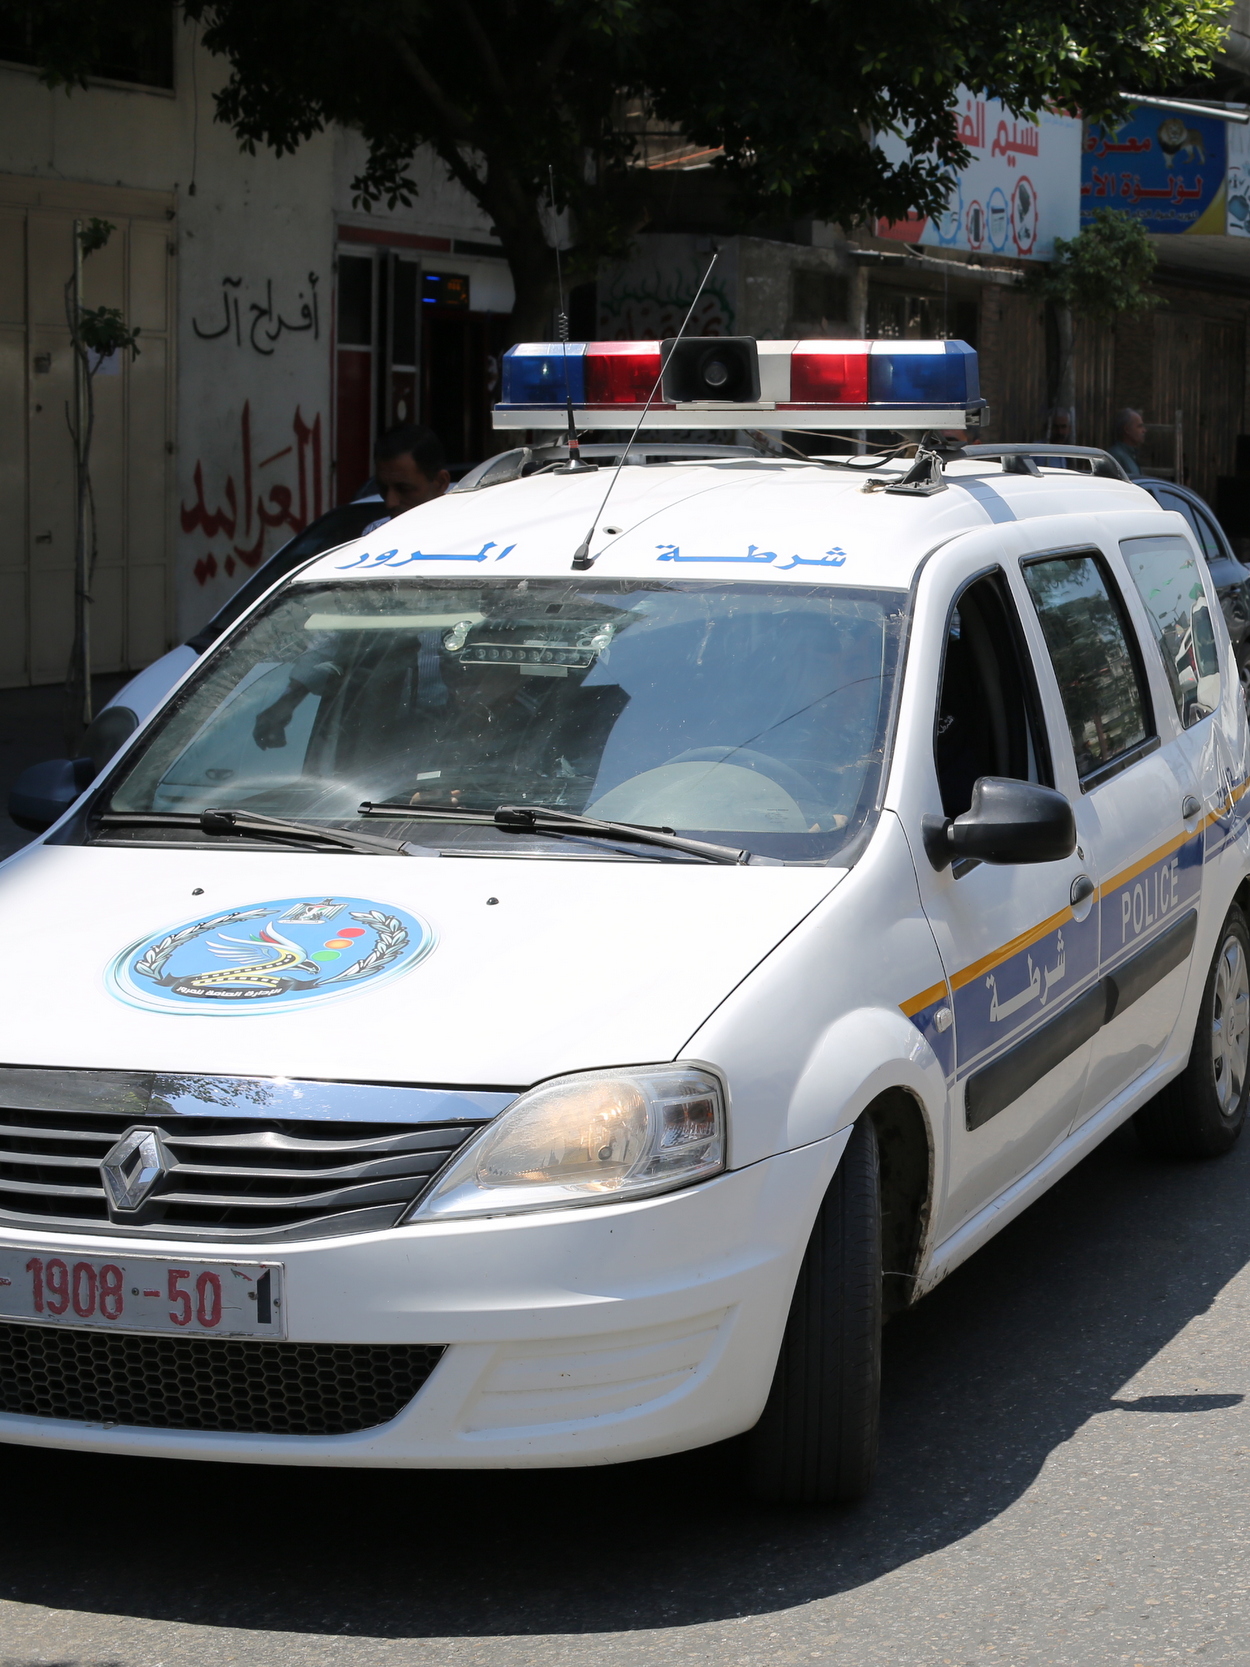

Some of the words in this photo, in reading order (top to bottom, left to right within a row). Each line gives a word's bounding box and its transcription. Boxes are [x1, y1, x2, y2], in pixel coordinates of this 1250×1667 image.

[1120, 172, 1204, 206] لؤلؤة
[192, 276, 242, 347] آل
[249, 271, 319, 356] أفراح
[334, 541, 519, 570] المرور
[655, 545, 848, 571] شرطة
[1121, 857, 1179, 944] POLICE
[205, 989, 242, 998] العامة
[985, 928, 1067, 1023] شرطة
